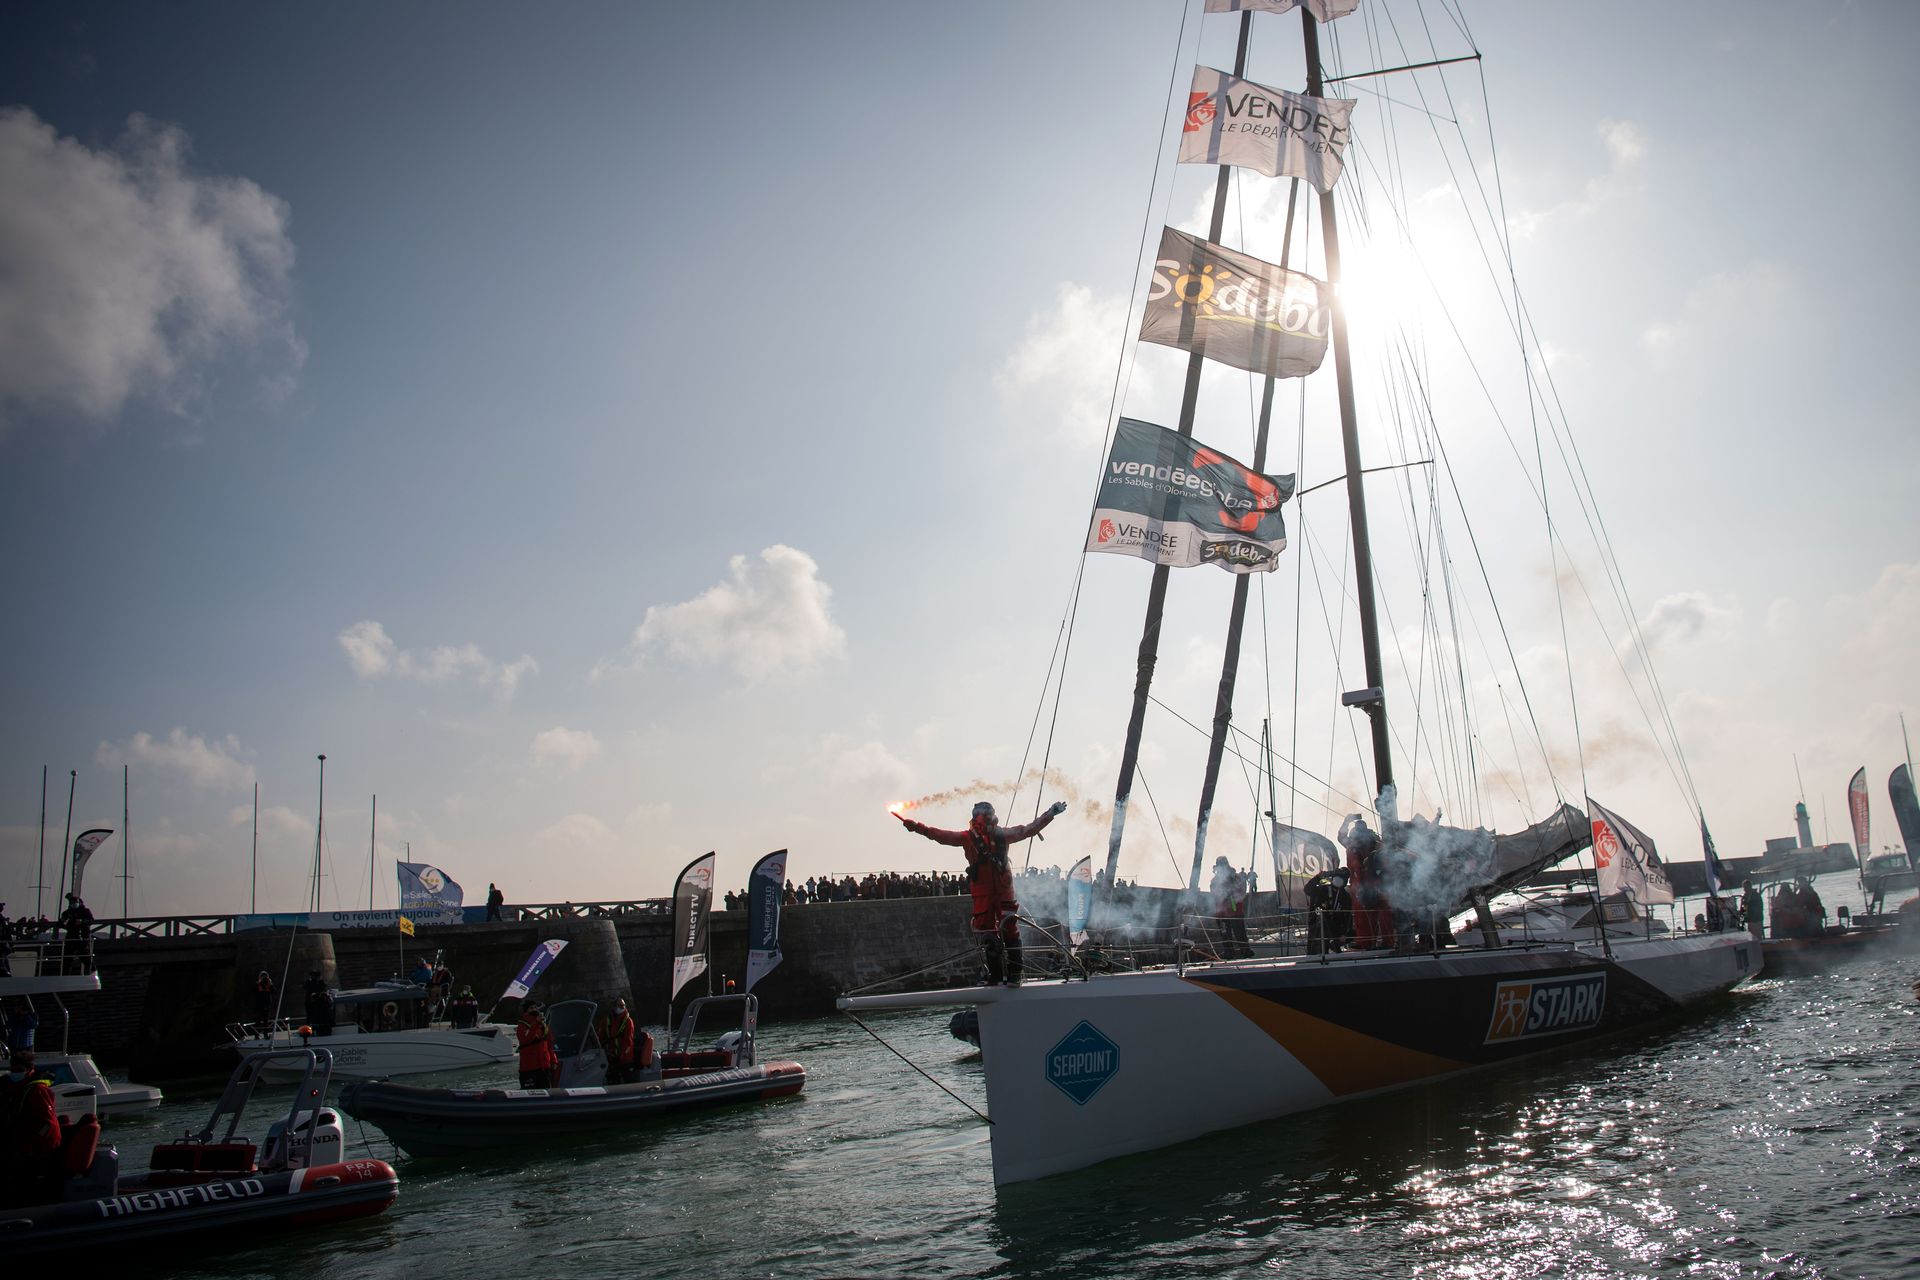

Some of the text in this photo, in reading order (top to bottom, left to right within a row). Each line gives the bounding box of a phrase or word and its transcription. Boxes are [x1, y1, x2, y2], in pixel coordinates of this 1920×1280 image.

[1219, 122, 1237, 132] LE
[1109, 476, 1123, 485] Les
[1125, 476, 1154, 489] Sables
[1118, 523, 1178, 548] VENDÉE
[332, 912, 349, 922] On
[353, 911, 391, 921] revient
[395, 910, 441, 922] toujours
[763, 886, 772, 933] HIGHFIELD
[687, 893, 699, 948] DIRECT TV
[1528, 982, 1602, 1030] STARK
[1054, 1049, 1113, 1078] SEAPOINT
[682, 1069, 751, 1087] HIGHFIELD
[290, 1134, 338, 1147] HONDA
[346, 1161, 377, 1172] FRA
[357, 1170, 373, 1179] 14
[97, 1179, 265, 1217] HIGHFIELD
